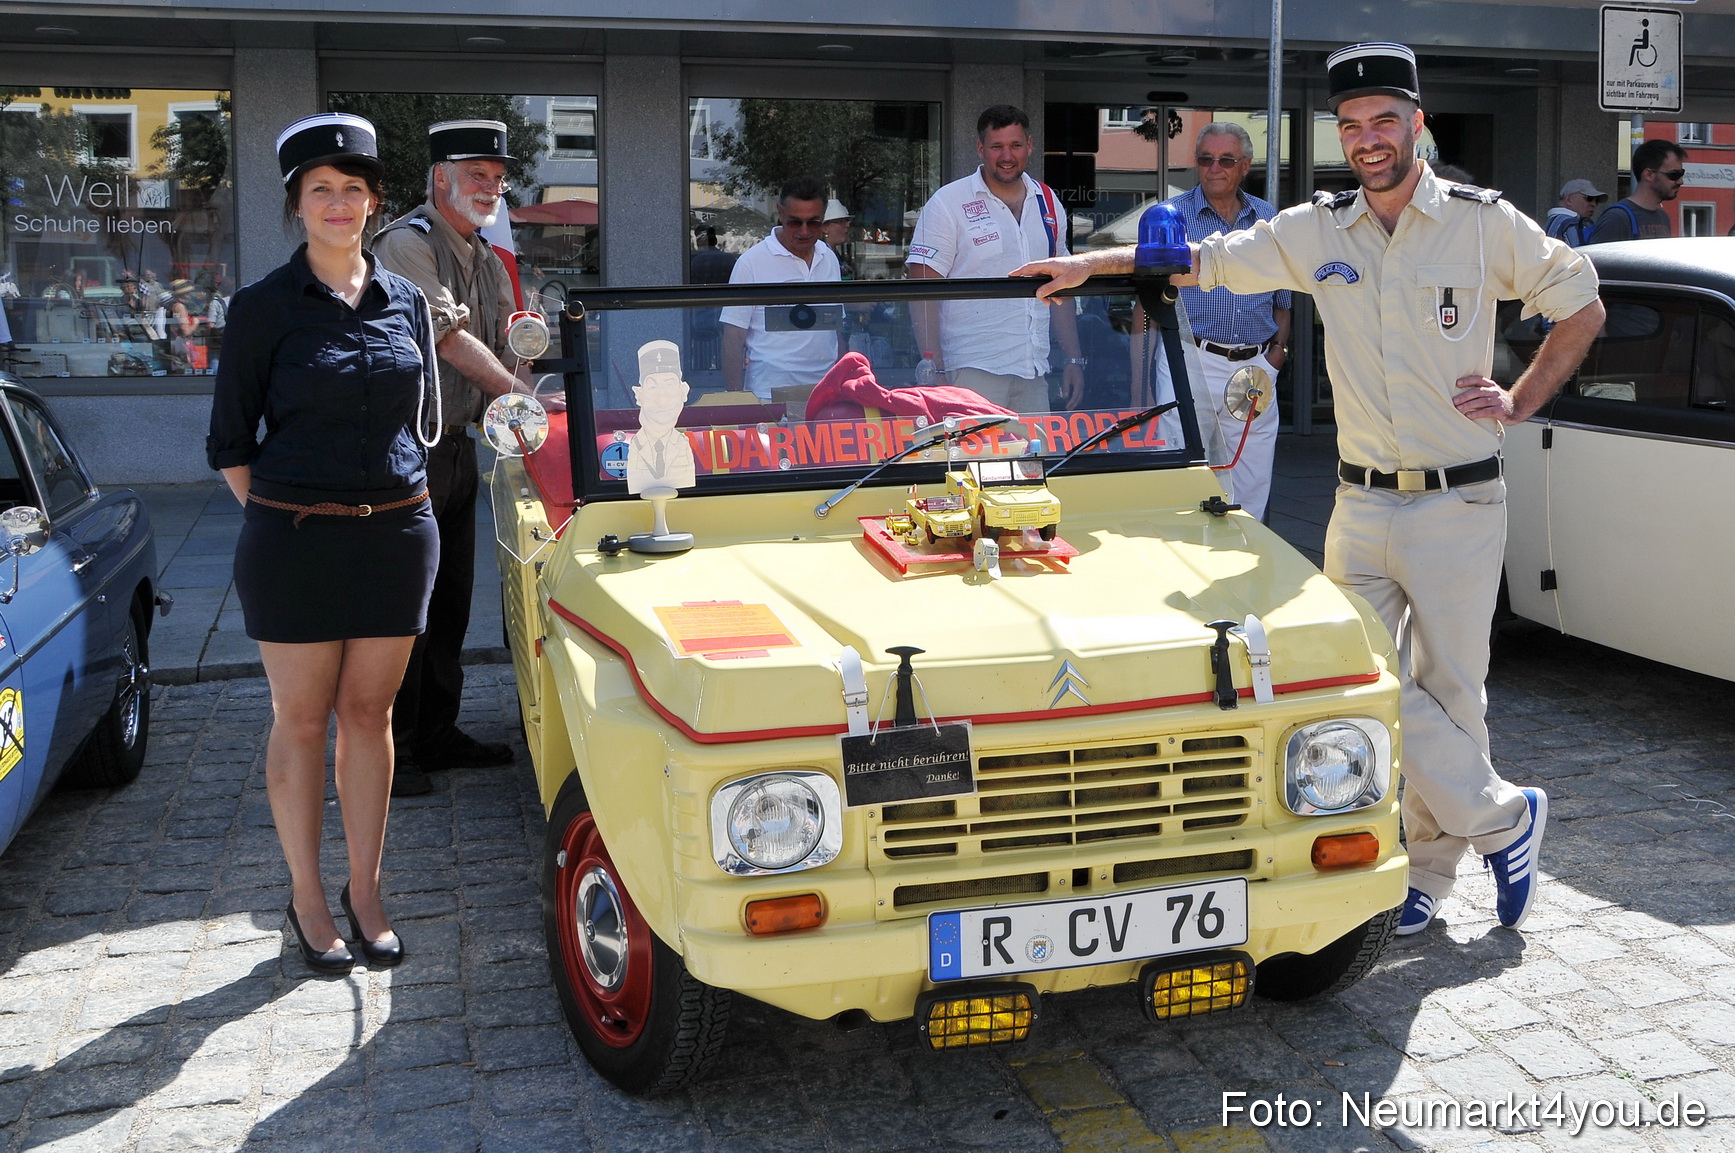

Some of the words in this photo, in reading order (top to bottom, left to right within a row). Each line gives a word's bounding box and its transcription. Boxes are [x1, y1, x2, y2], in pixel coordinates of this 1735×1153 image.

[1627, 80, 1659, 88] Parkausweis
[1636, 91, 1659, 101] Fahrzeug
[45, 174, 129, 207] Weil
[1053, 185, 1109, 202] erzlich
[15, 214, 100, 232] Schuhe
[107, 216, 177, 234] lieben.
[684, 419, 918, 470] NDARMERIE
[1019, 411, 1166, 453] TROPEZ
[848, 762, 876, 774] Bitte
[879, 757, 909, 770] nicht
[913, 750, 969, 766] berühren!
[926, 771, 960, 783] Danke!
[983, 916, 1015, 966] R
[1069, 902, 1133, 957] CV
[1166, 891, 1224, 944] 76
[940, 953, 951, 967] D
